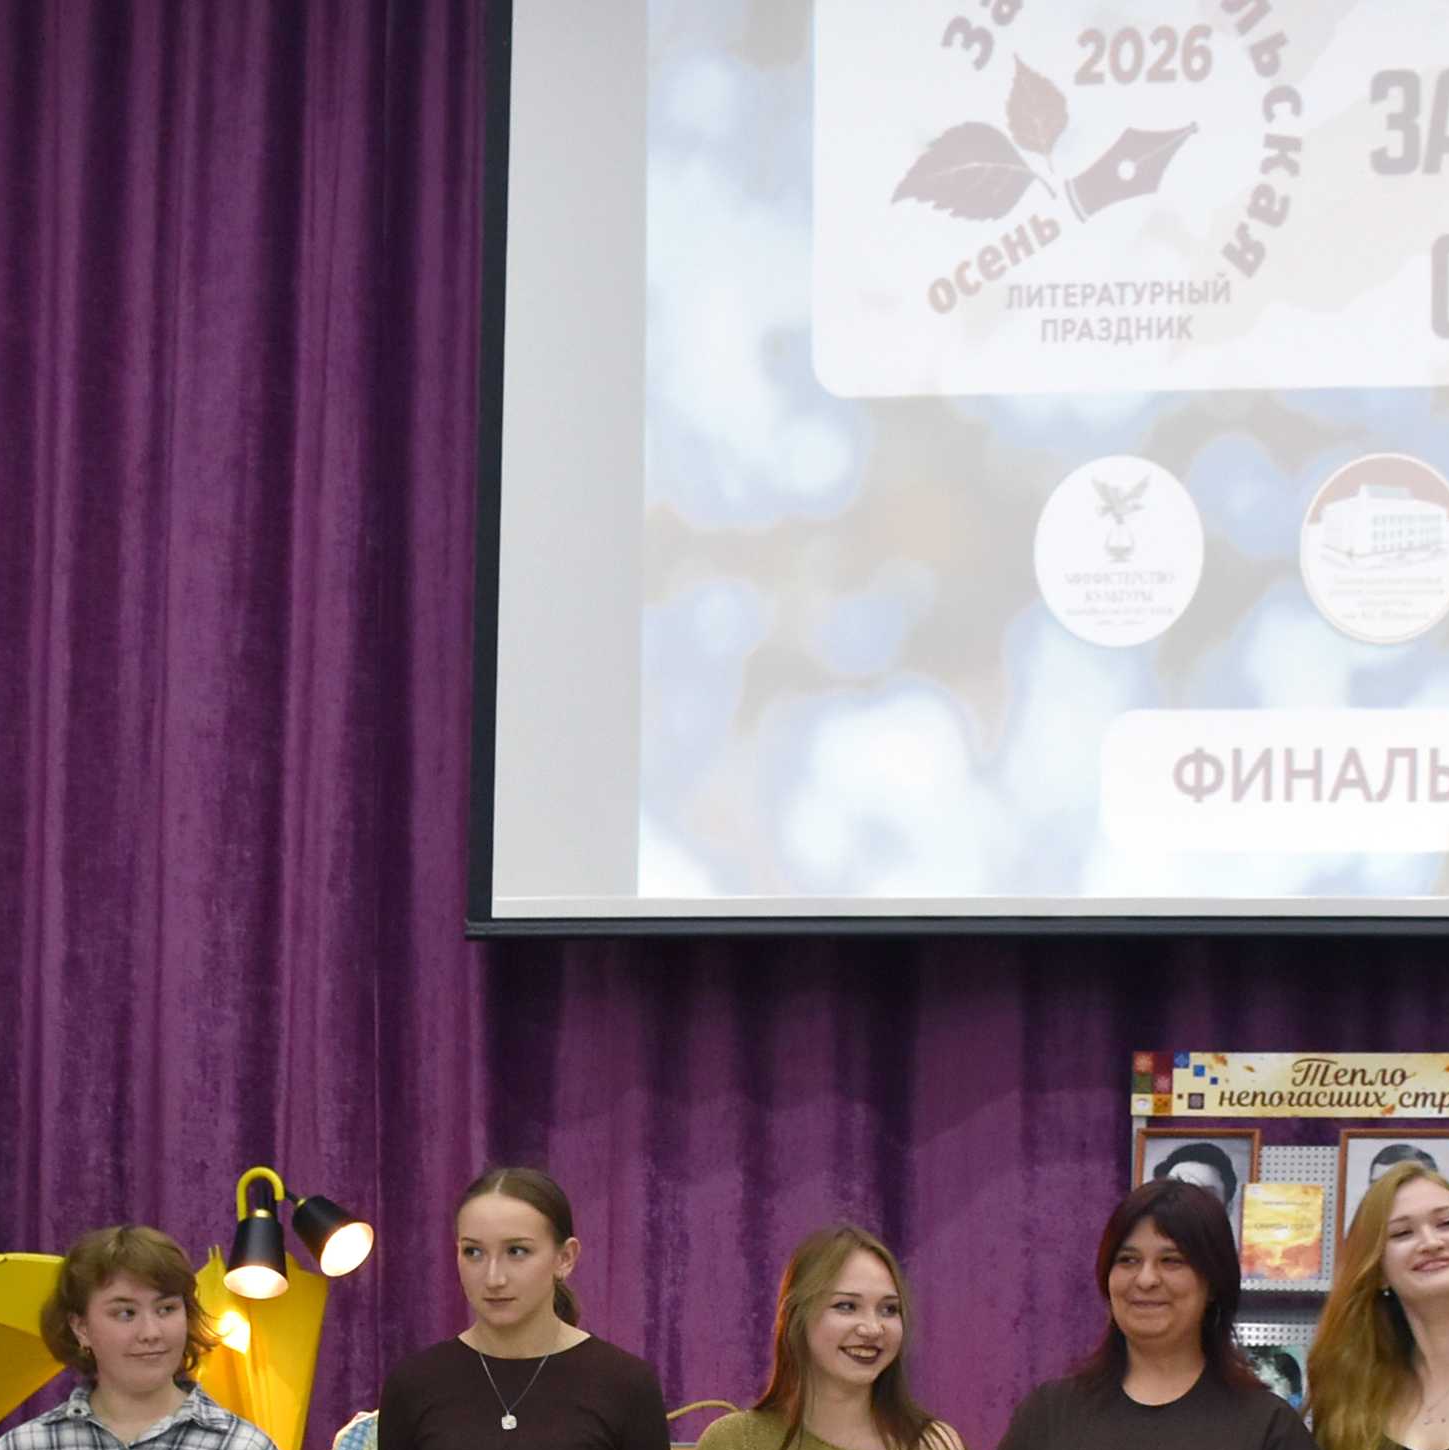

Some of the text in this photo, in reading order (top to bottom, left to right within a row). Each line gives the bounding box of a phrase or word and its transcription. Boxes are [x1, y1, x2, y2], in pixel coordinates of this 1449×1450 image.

[1073, 24, 1214, 85] 2026
[927, 214, 1061, 315] осень
[1006, 273, 1232, 309] ЛИТЕРАТУРНЫЙ
[1040, 314, 1194, 345] ПРАЗДНИК
[1291, 1057, 1416, 1088] Тепло
[1218, 1087, 1388, 1109] непогасших
